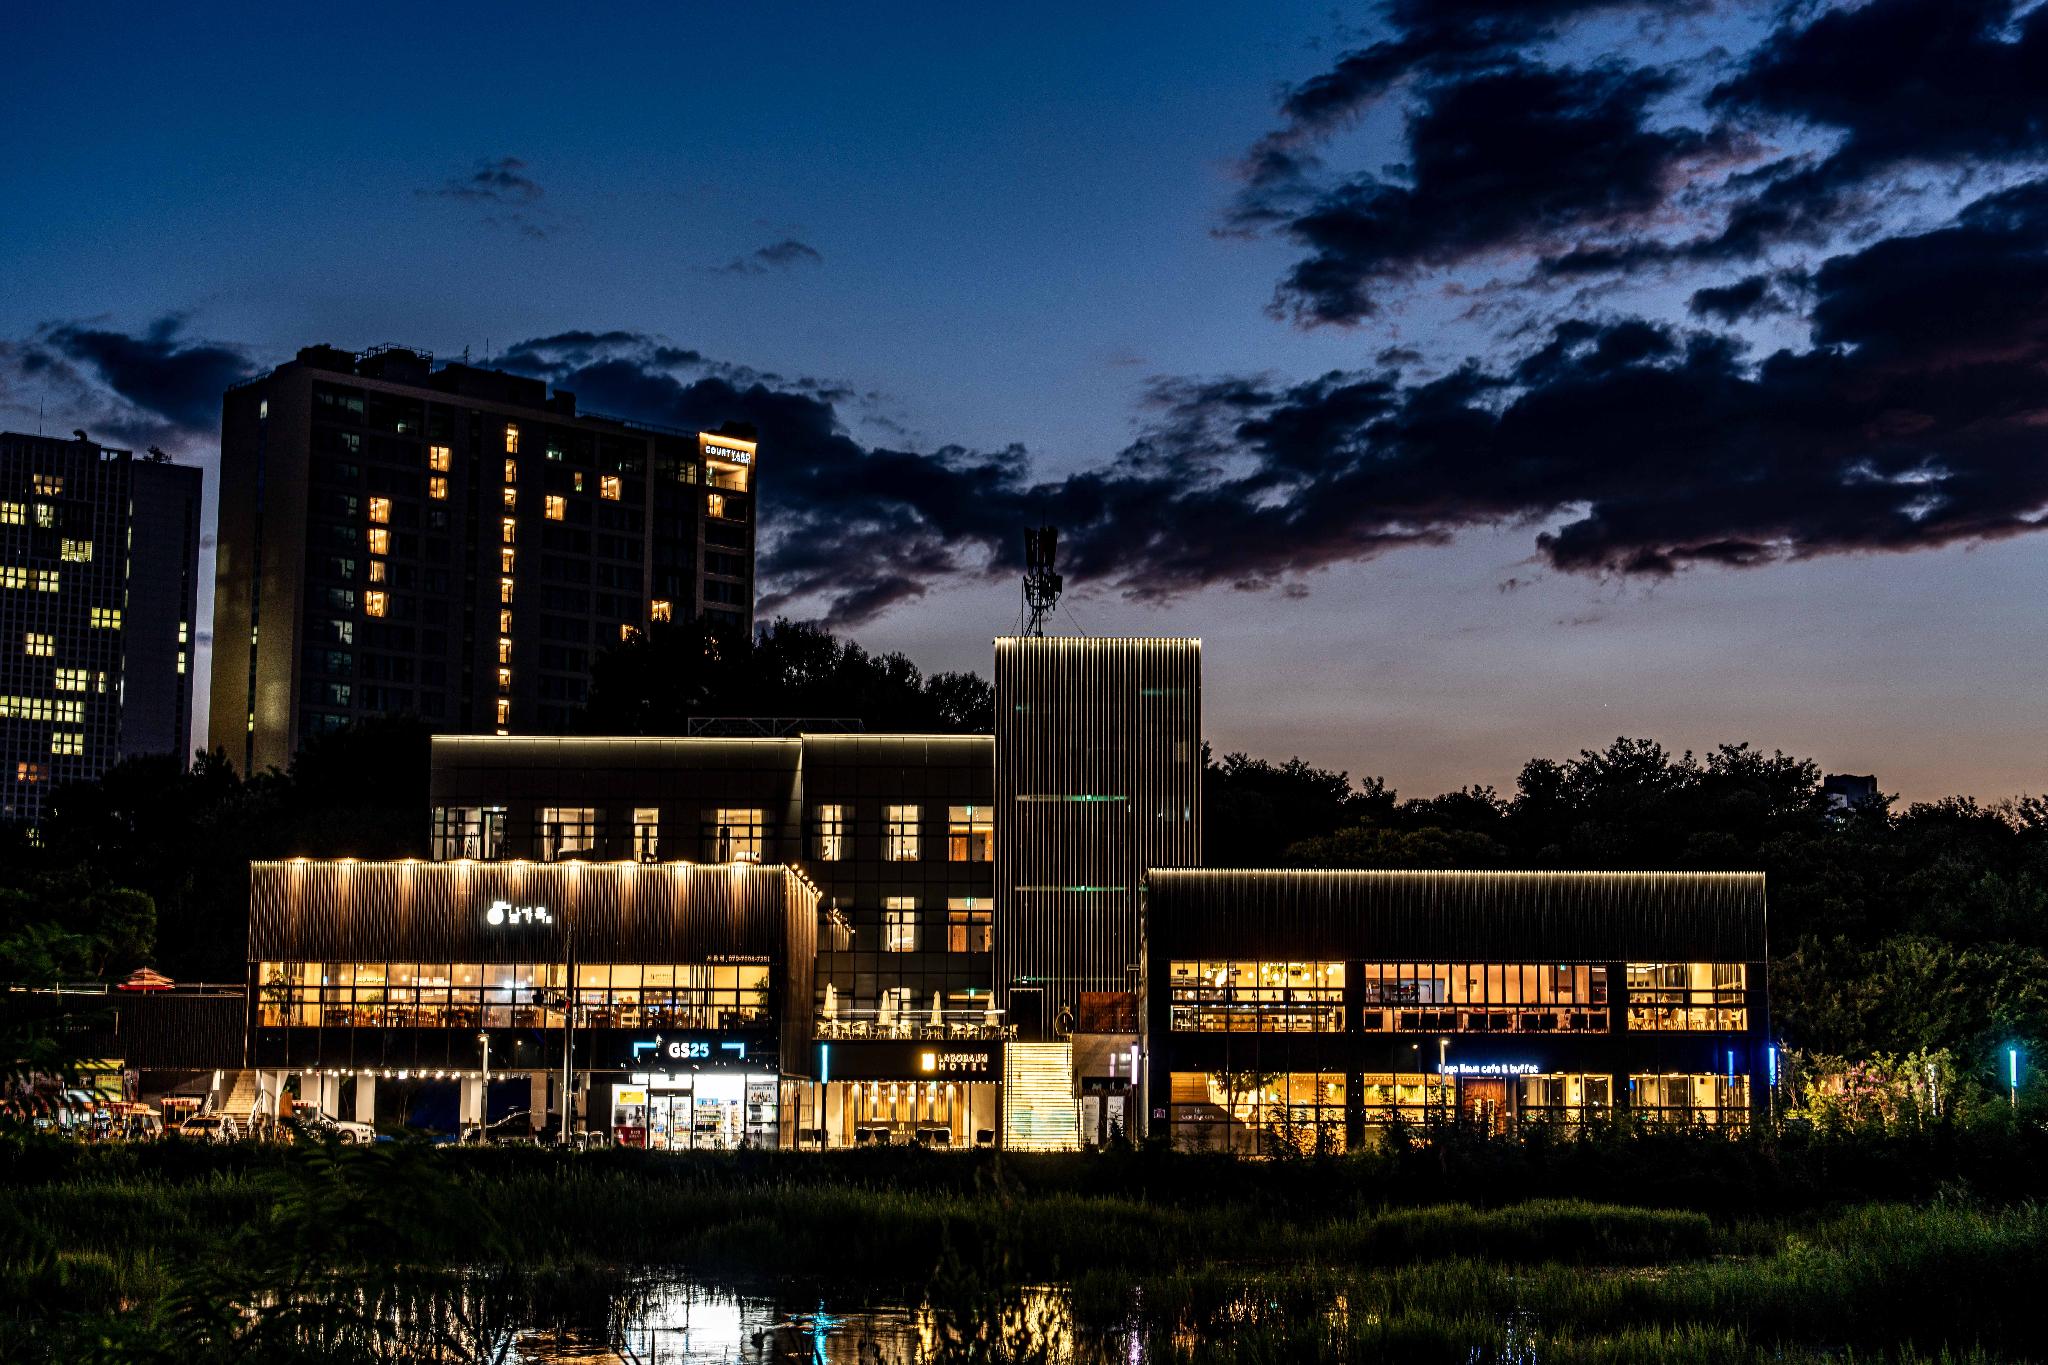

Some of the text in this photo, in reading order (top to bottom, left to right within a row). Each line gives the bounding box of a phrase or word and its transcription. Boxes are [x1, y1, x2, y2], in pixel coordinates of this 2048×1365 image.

[705, 445, 751, 461] COURTYARD
[668, 1042, 710, 1058] GS25
[938, 1062, 987, 1071] HOTEL
[1481, 1063, 1501, 1073] cafe
[1510, 1063, 1539, 1073] buffet
